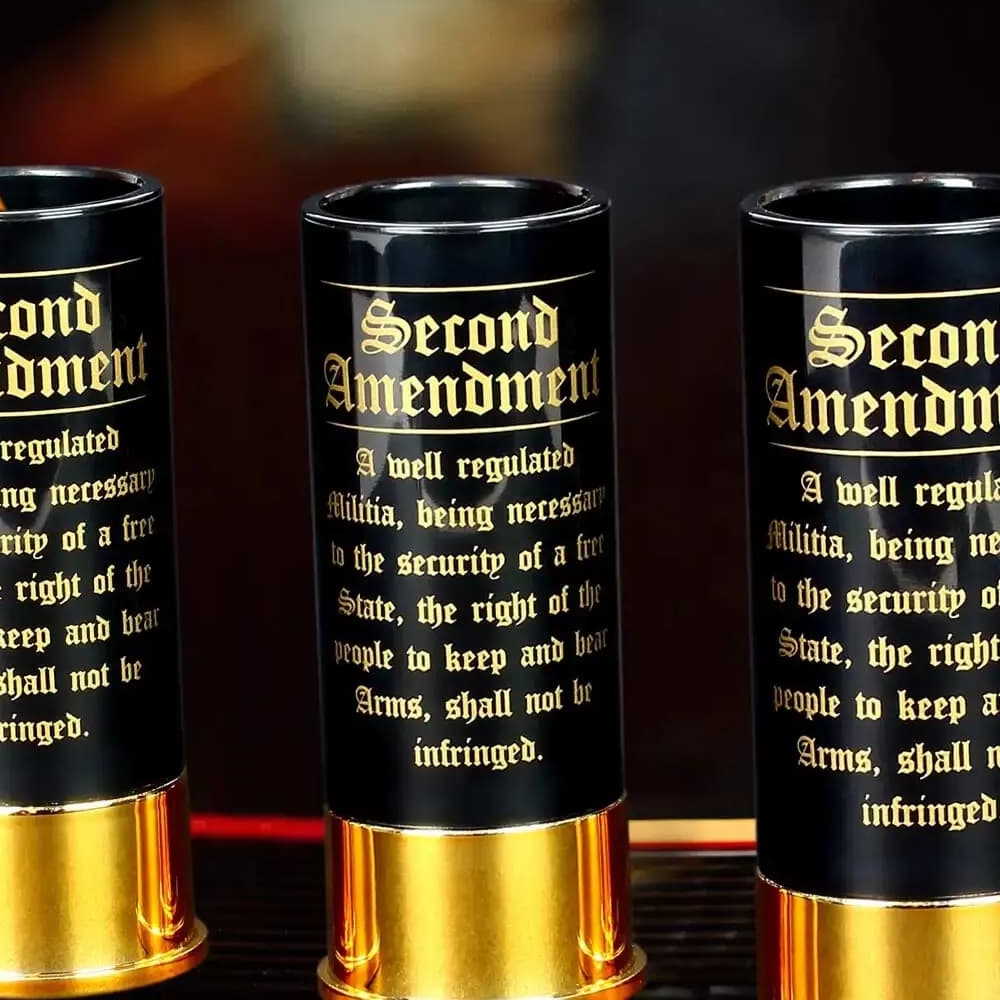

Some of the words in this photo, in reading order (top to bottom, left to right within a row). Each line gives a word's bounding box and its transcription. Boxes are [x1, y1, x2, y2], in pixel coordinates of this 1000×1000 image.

[360, 294, 559, 357] Second
[323, 348, 600, 418] Amendment
[0, 424, 120, 465] regulated
[355, 447, 377, 477] A
[386, 450, 445, 480] well
[456, 442, 575, 484] regulated
[49, 468, 156, 506] necessary
[800, 470, 823, 504] A
[836, 475, 900, 507] well
[327, 490, 404, 531] Militia,
[416, 498, 495, 532] being
[62, 522, 87, 552] of
[98, 525, 112, 548] a
[122, 514, 155, 542] free
[766, 519, 853, 564] Militia,
[868, 528, 954, 565] being
[331, 540, 345, 567] to
[353, 543, 385, 577] the
[397, 545, 506, 580] security
[518, 541, 543, 572] of
[553, 544, 567, 567] a
[15, 572, 82, 606] right
[93, 565, 116, 595] of
[125, 560, 152, 591] the
[337, 587, 404, 627] State,
[417, 595, 457, 629] the
[471, 591, 537, 627] right
[548, 585, 569, 615] of
[578, 579, 601, 612] the
[771, 575, 786, 603] to
[797, 577, 832, 615] the
[846, 581, 967, 619] security
[981, 579, 1000, 610] o
[65, 615, 111, 646] and
[121, 607, 160, 637] bear
[334, 639, 394, 673] people
[406, 645, 431, 672] to
[443, 643, 507, 675] keep
[520, 636, 564, 668] and
[575, 628, 608, 657] bear
[778, 627, 852, 670] State,
[867, 636, 913, 673] the
[928, 632, 1000, 672] right
[70, 663, 110, 692] not
[120, 656, 143, 684] be
[355, 684, 431, 723] Arms,
[445, 688, 513, 725] shall
[524, 685, 564, 715] not
[572, 677, 592, 706] be
[773, 685, 841, 721] people
[855, 691, 882, 721] to
[897, 689, 967, 725] keep
[413, 735, 543, 771] infringed.
[796, 735, 881, 777] Arms,
[897, 739, 973, 781] shall
